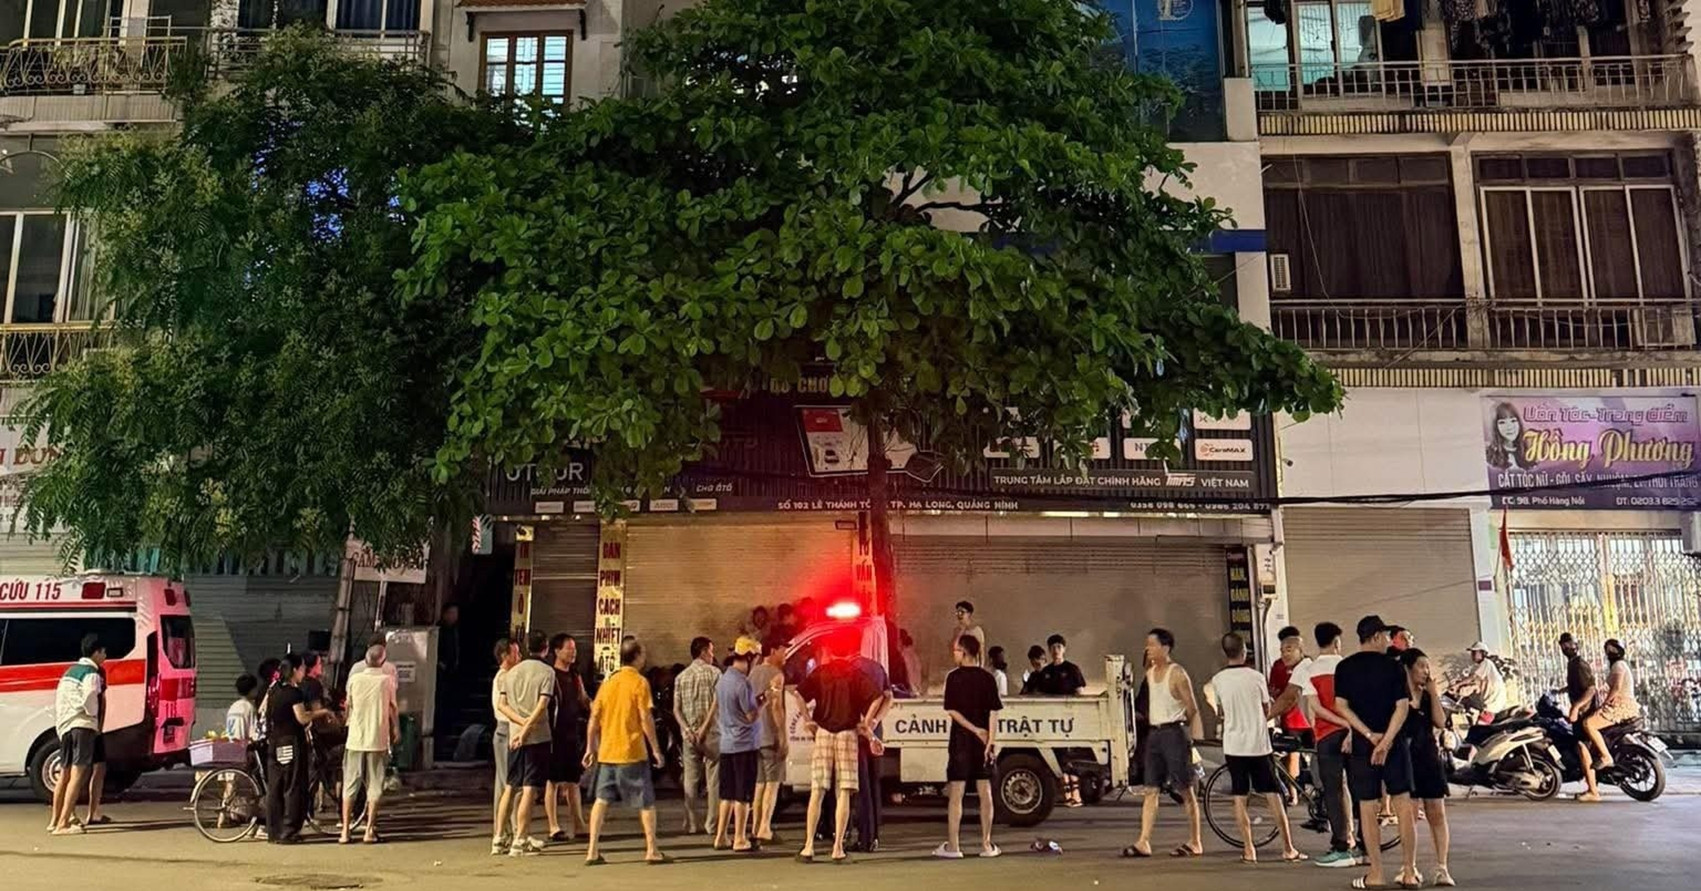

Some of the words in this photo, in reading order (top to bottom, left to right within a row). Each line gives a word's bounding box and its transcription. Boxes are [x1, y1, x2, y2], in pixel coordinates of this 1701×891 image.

[1524, 427, 1591, 470] Hồng
[1600, 428, 1695, 470] Phương
[994, 475, 1028, 485] TRUNG
[1030, 474, 1051, 485] TÂM
[1097, 475, 1129, 486] CHÍNH
[1132, 475, 1161, 486] HÃNG
[1200, 477, 1224, 489] VIỆT
[1225, 479, 1249, 488] NAM
[778, 499, 791, 510] SỐ
[812, 499, 823, 509] LÊ
[825, 500, 857, 509] THÁNH
[956, 499, 990, 510] QUẢNG
[36, 582, 62, 600] 115
[895, 713, 947, 733] CẢNH
[997, 715, 1043, 738] TRẬT
[1048, 716, 1074, 738] TỰ
